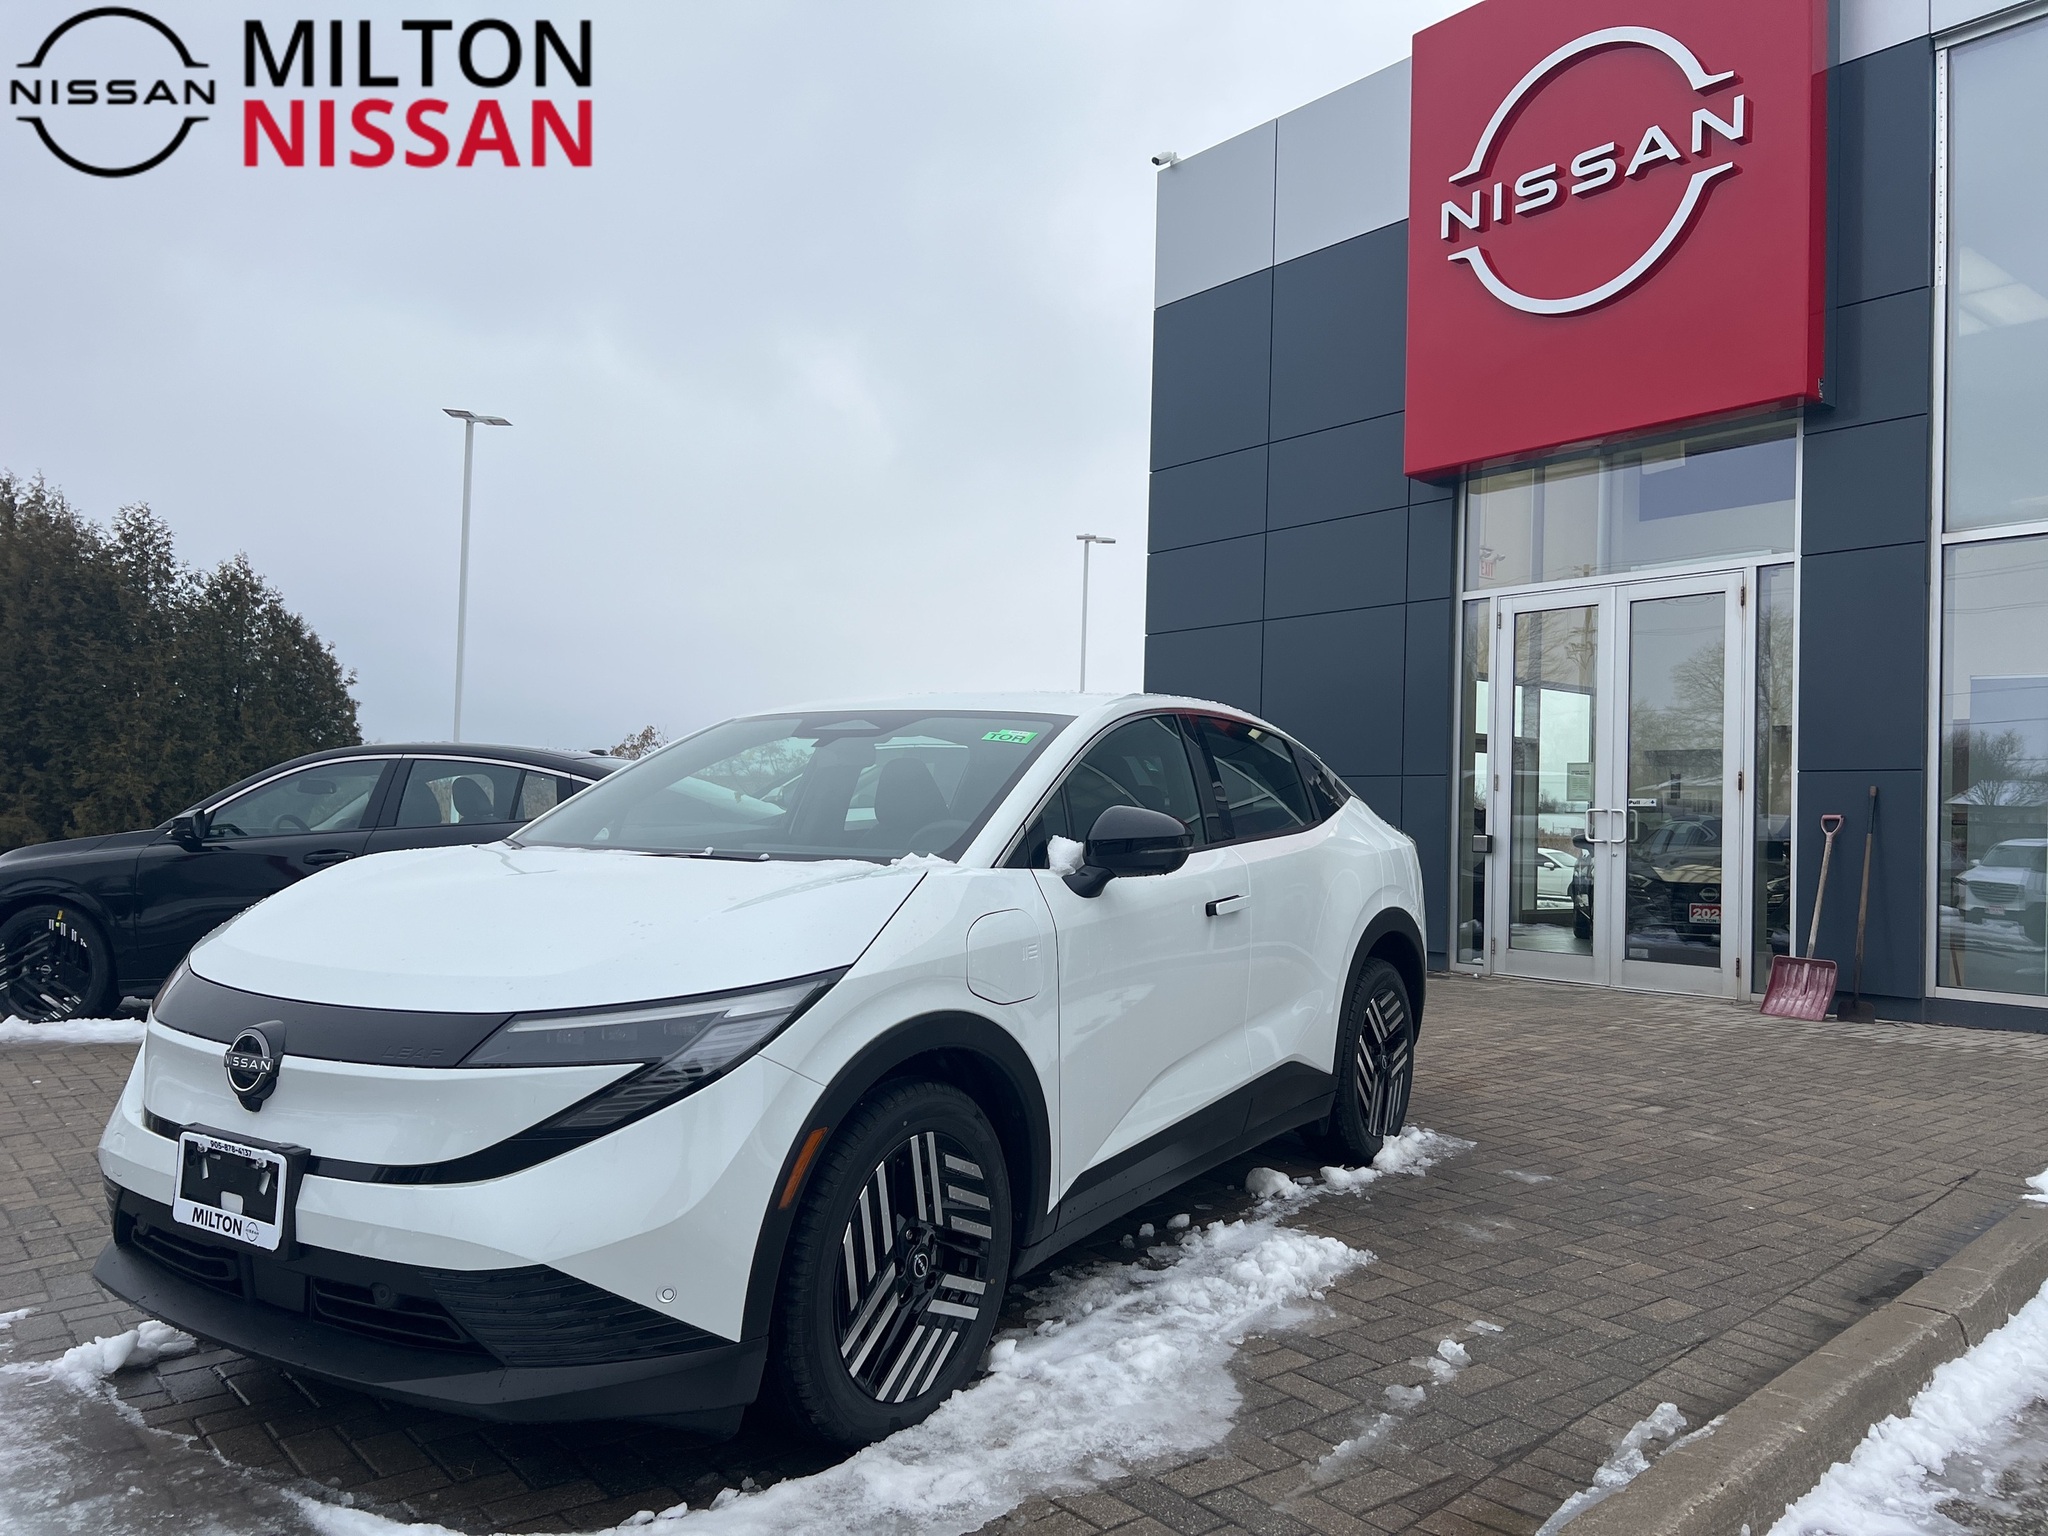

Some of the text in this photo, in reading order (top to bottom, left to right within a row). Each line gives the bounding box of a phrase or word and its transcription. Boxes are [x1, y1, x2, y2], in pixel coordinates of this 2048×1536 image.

[1441, 94, 1745, 240] NISSAN
[990, 732, 1026, 743] TOR
[382, 1045, 444, 1060] LEAF
[225, 1054, 271, 1071] NISSAN
[192, 1207, 243, 1237] MILTON
